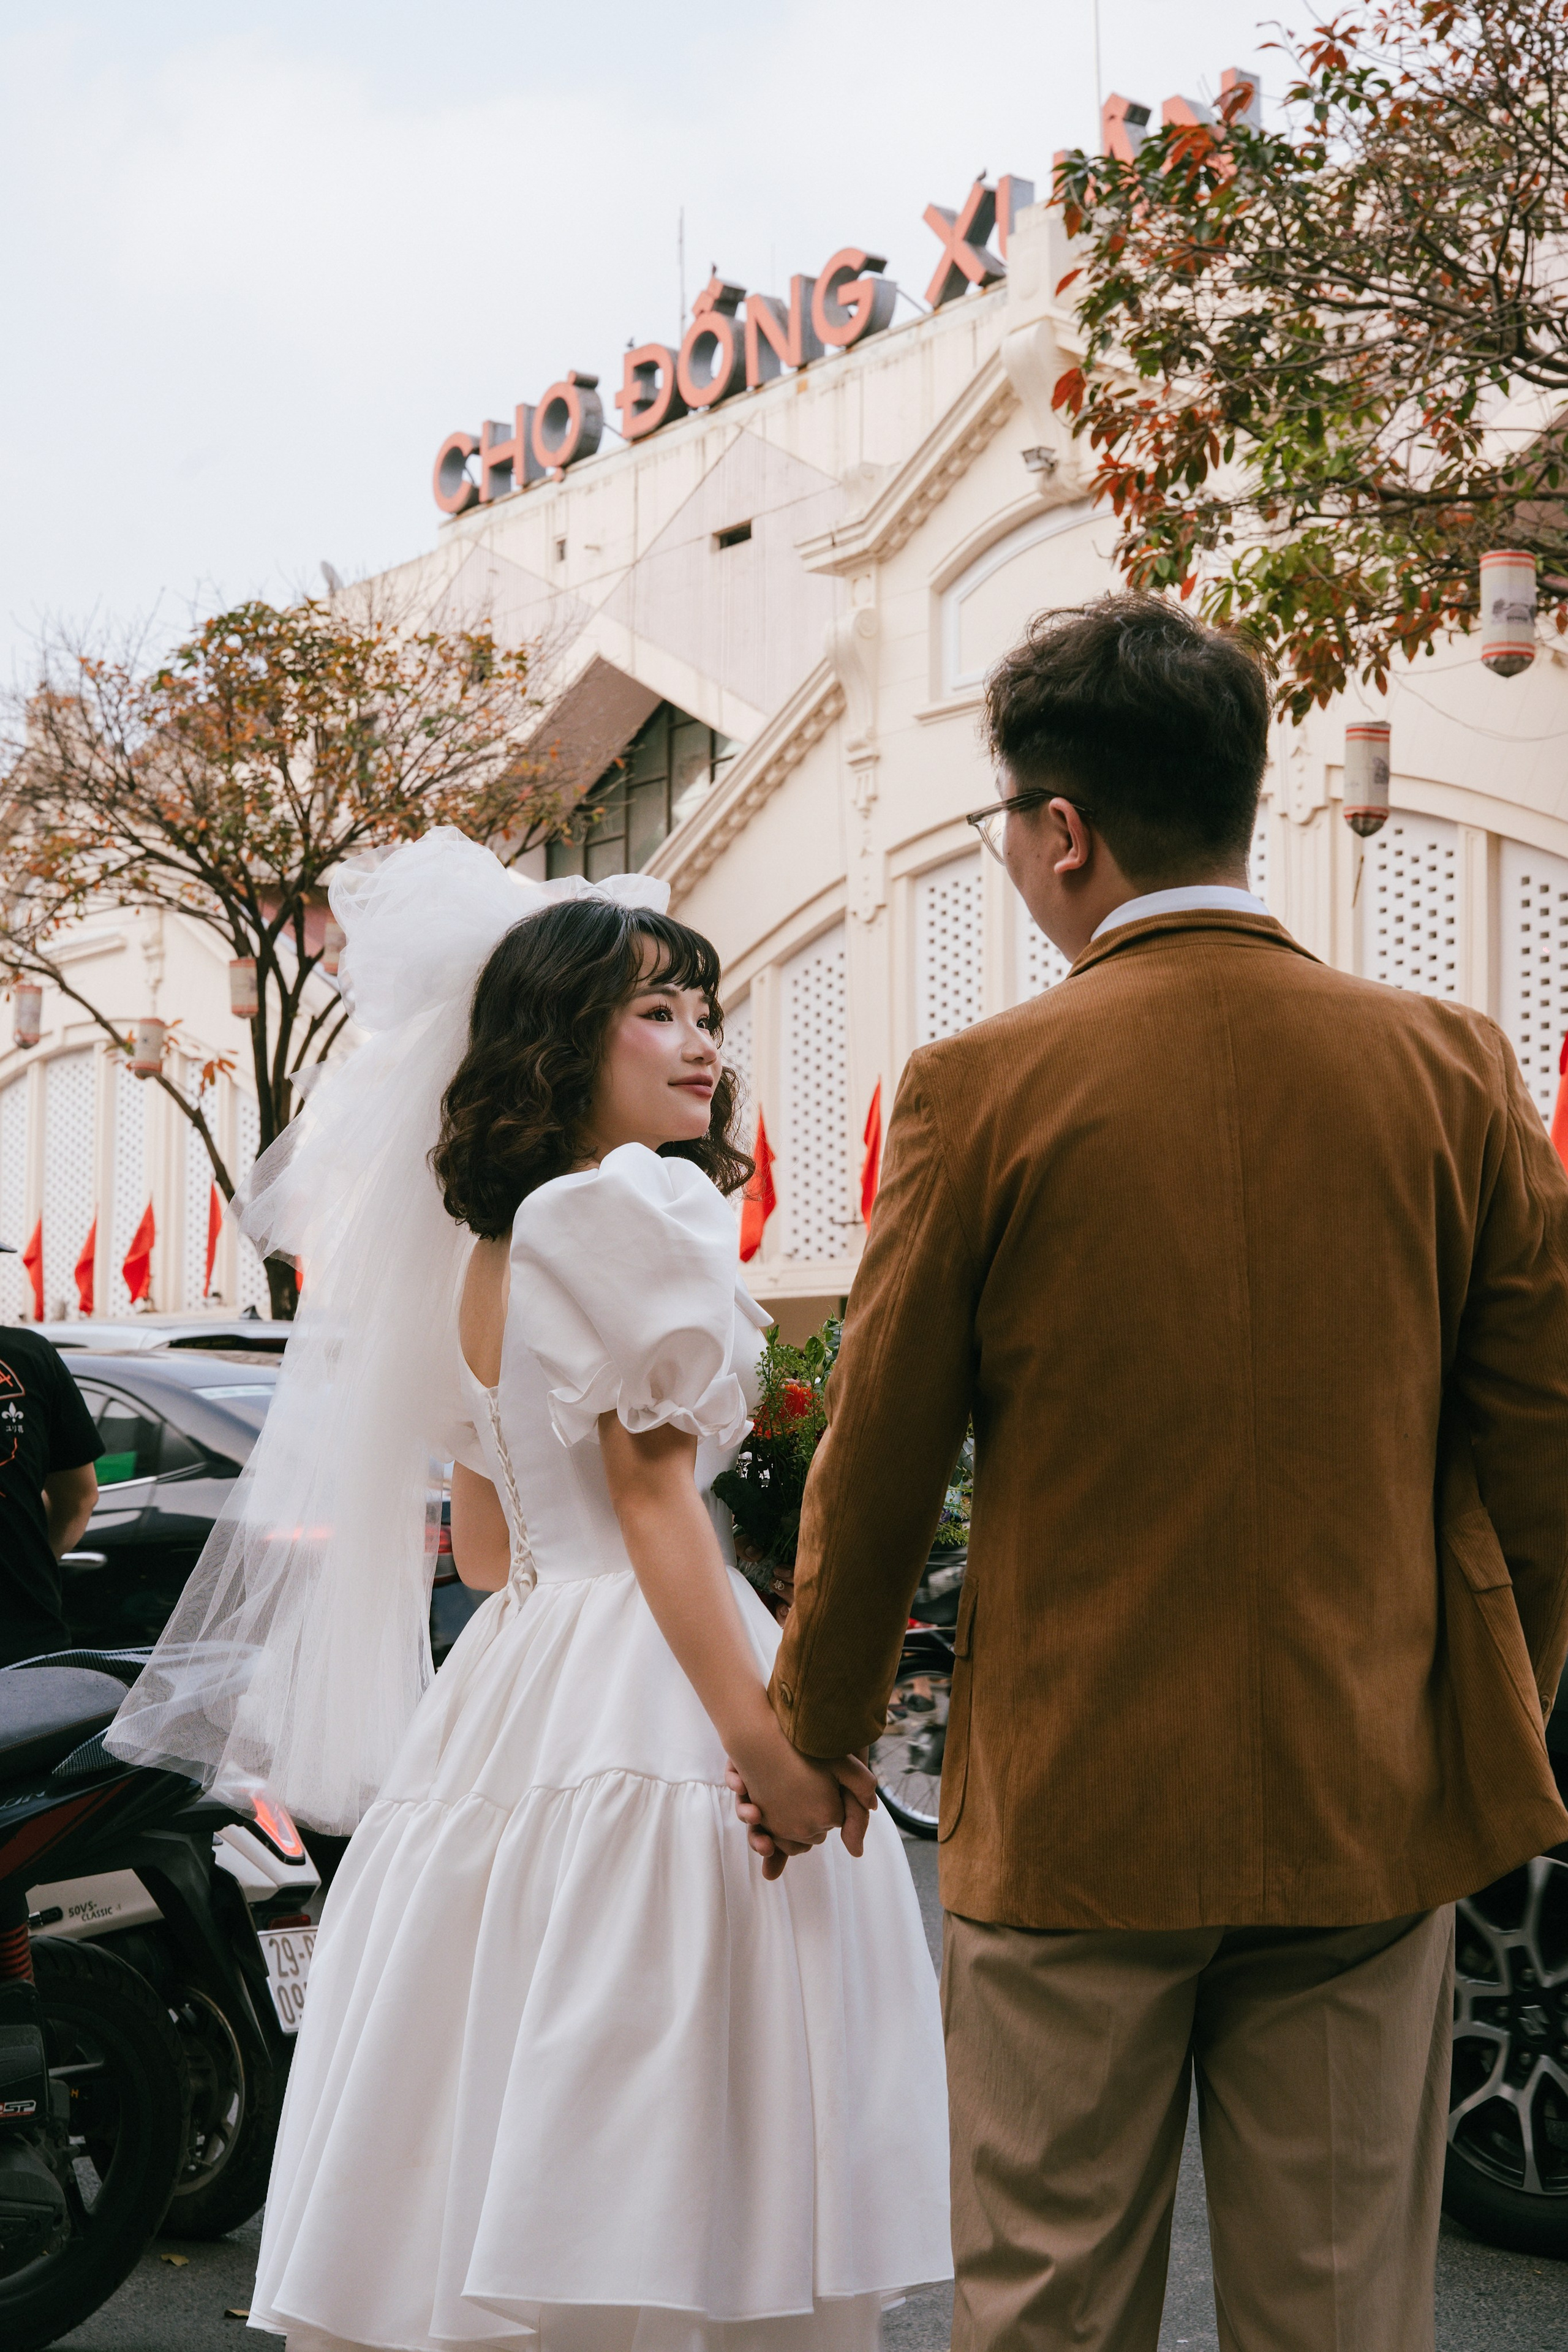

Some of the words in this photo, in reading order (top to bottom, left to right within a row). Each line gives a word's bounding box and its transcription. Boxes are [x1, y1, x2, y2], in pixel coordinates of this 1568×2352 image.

[433, 369, 603, 513] CHỢ
[81, 1906, 113, 1921] CLASSIC
[277, 1981, 307, 2024] 09
